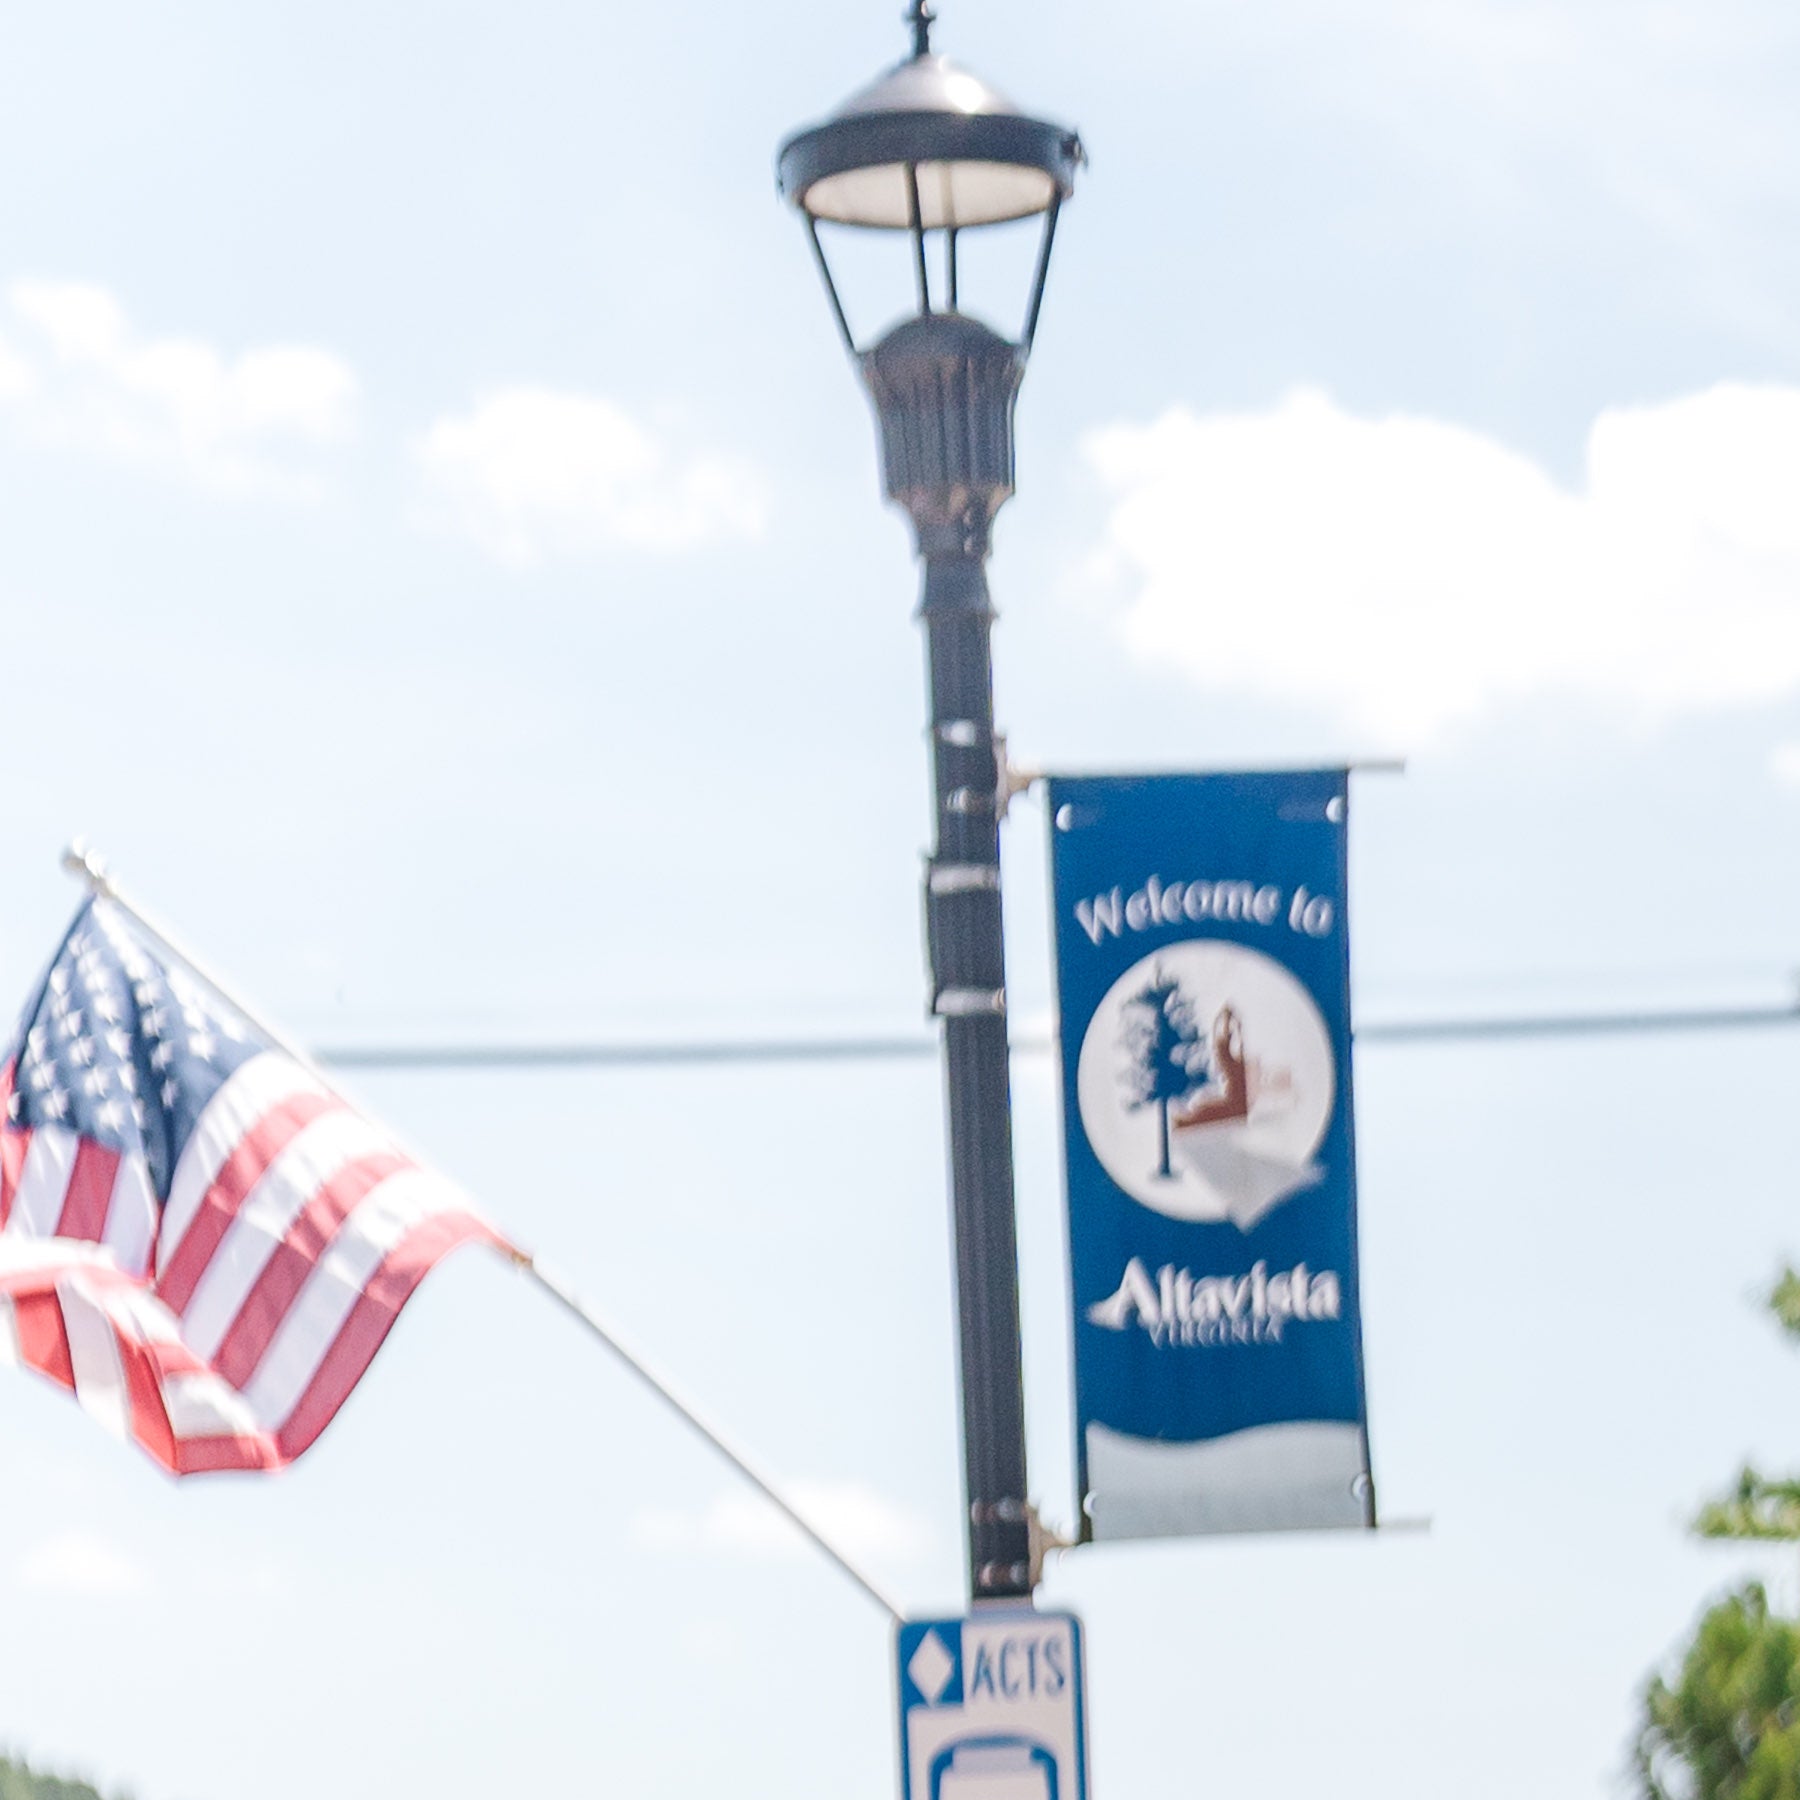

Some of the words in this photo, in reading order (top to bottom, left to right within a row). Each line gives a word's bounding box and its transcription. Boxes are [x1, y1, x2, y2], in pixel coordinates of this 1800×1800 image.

[1074, 873, 1281, 946] Welcome
[1288, 884, 1335, 938] to
[1086, 1256, 1342, 1330] Altavista
[971, 1635, 1066, 1698] ACTS
